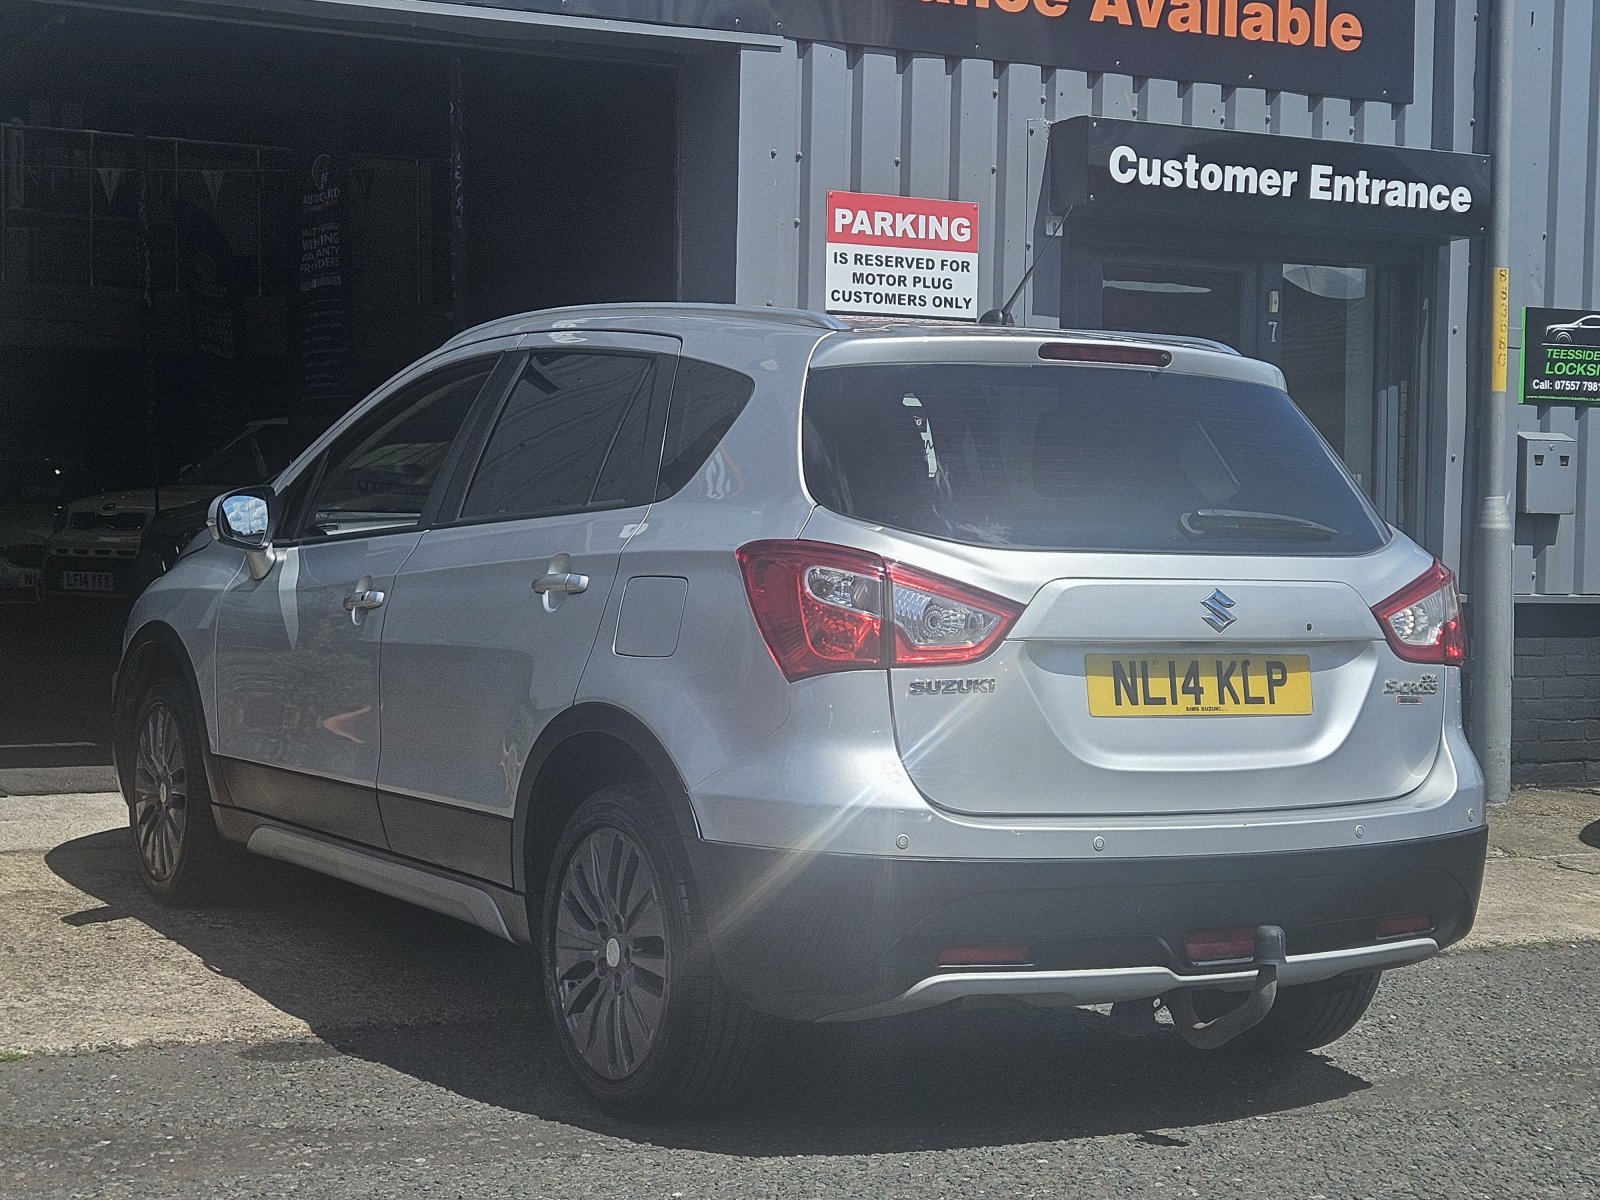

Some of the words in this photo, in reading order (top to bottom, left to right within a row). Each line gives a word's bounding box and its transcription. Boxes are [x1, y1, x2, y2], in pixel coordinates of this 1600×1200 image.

[1109, 145, 1298, 197] Customer
[1309, 164, 1472, 213] Entrance
[834, 207, 971, 242] PARKING
[833, 251, 849, 265] IS
[853, 253, 935, 271] RESERVED
[940, 259, 971, 273] FOR
[852, 272, 907, 288] MOTOR
[912, 276, 953, 290] PLUG
[831, 289, 927, 307] CUSTOMERS
[932, 296, 972, 310] ONLY
[1268, 321, 1278, 343] 7
[1546, 348, 1600, 361] TEESSIDE
[1532, 378, 1553, 390] Call:
[1554, 380, 1580, 391] 07557
[909, 678, 996, 696] SUZUKI
[1112, 660, 1204, 706] NL14
[1215, 659, 1288, 705] KLP
